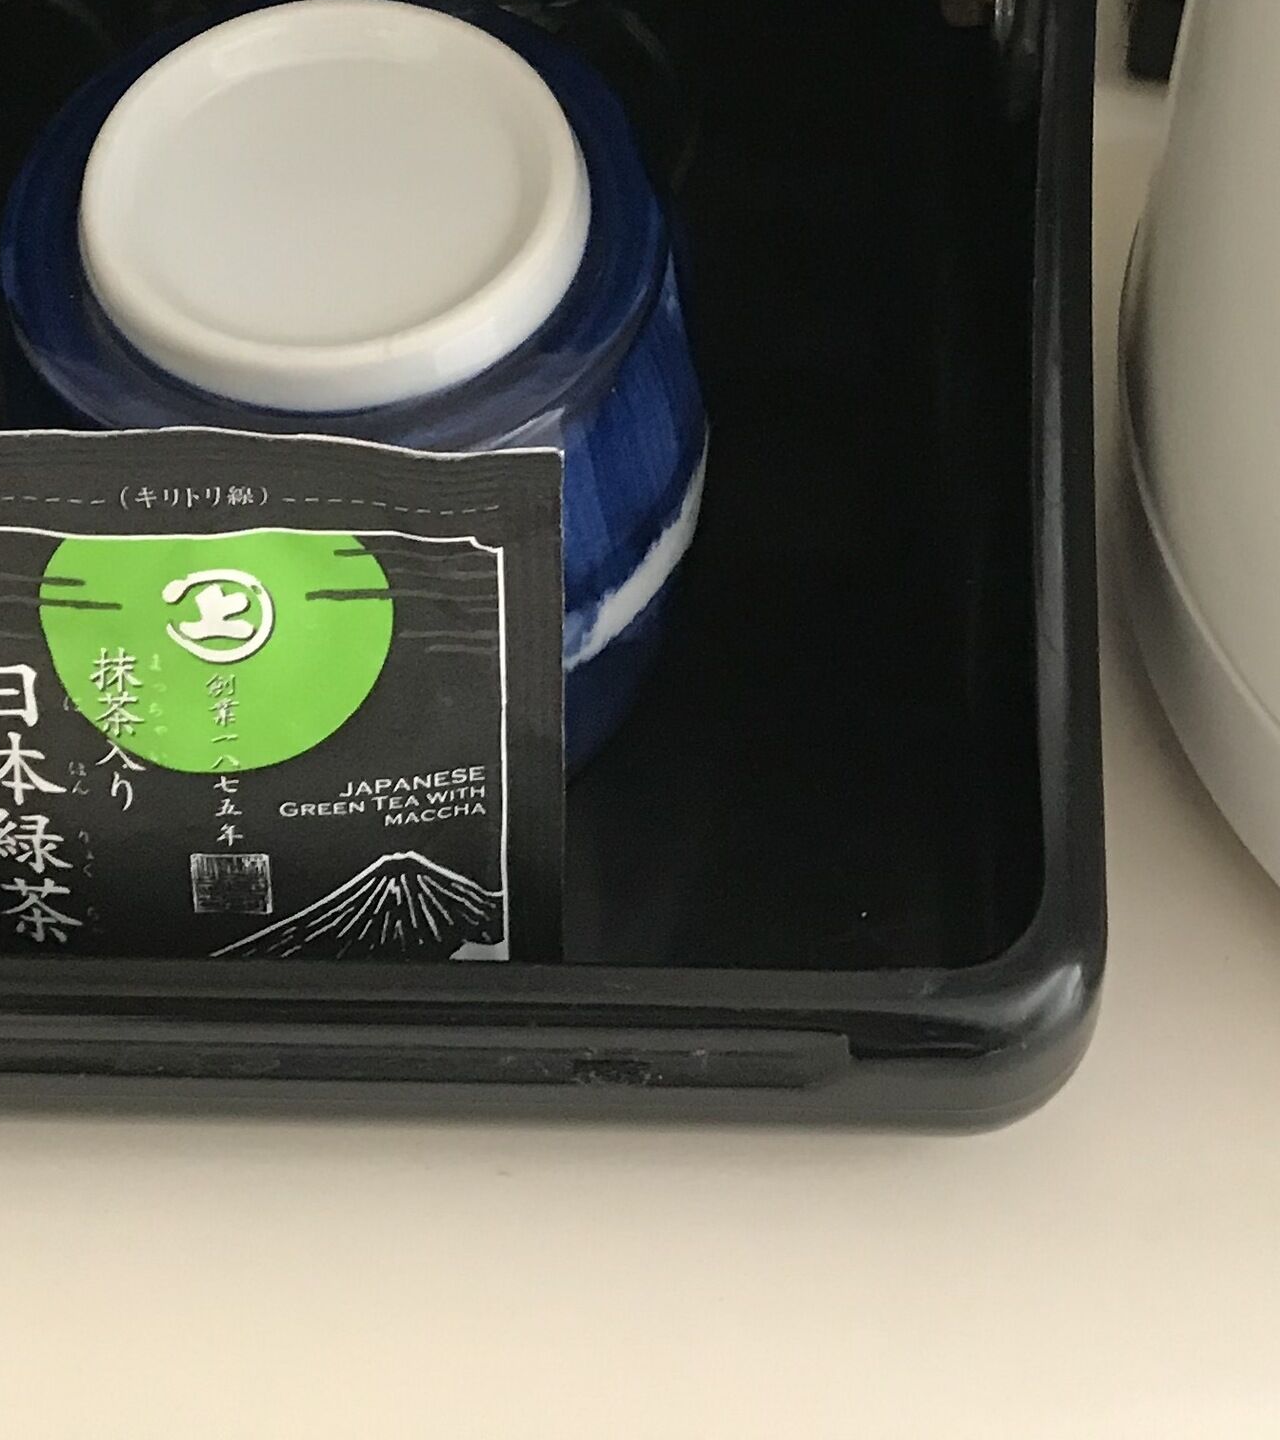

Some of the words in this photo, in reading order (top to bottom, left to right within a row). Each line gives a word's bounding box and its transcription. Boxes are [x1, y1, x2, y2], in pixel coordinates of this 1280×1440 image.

[88, 647, 147, 812] 抹茶入り
[339, 765, 486, 798] JAPANESE
[426, 785, 486, 806] WITH
[384, 802, 487, 828] MACCHA
